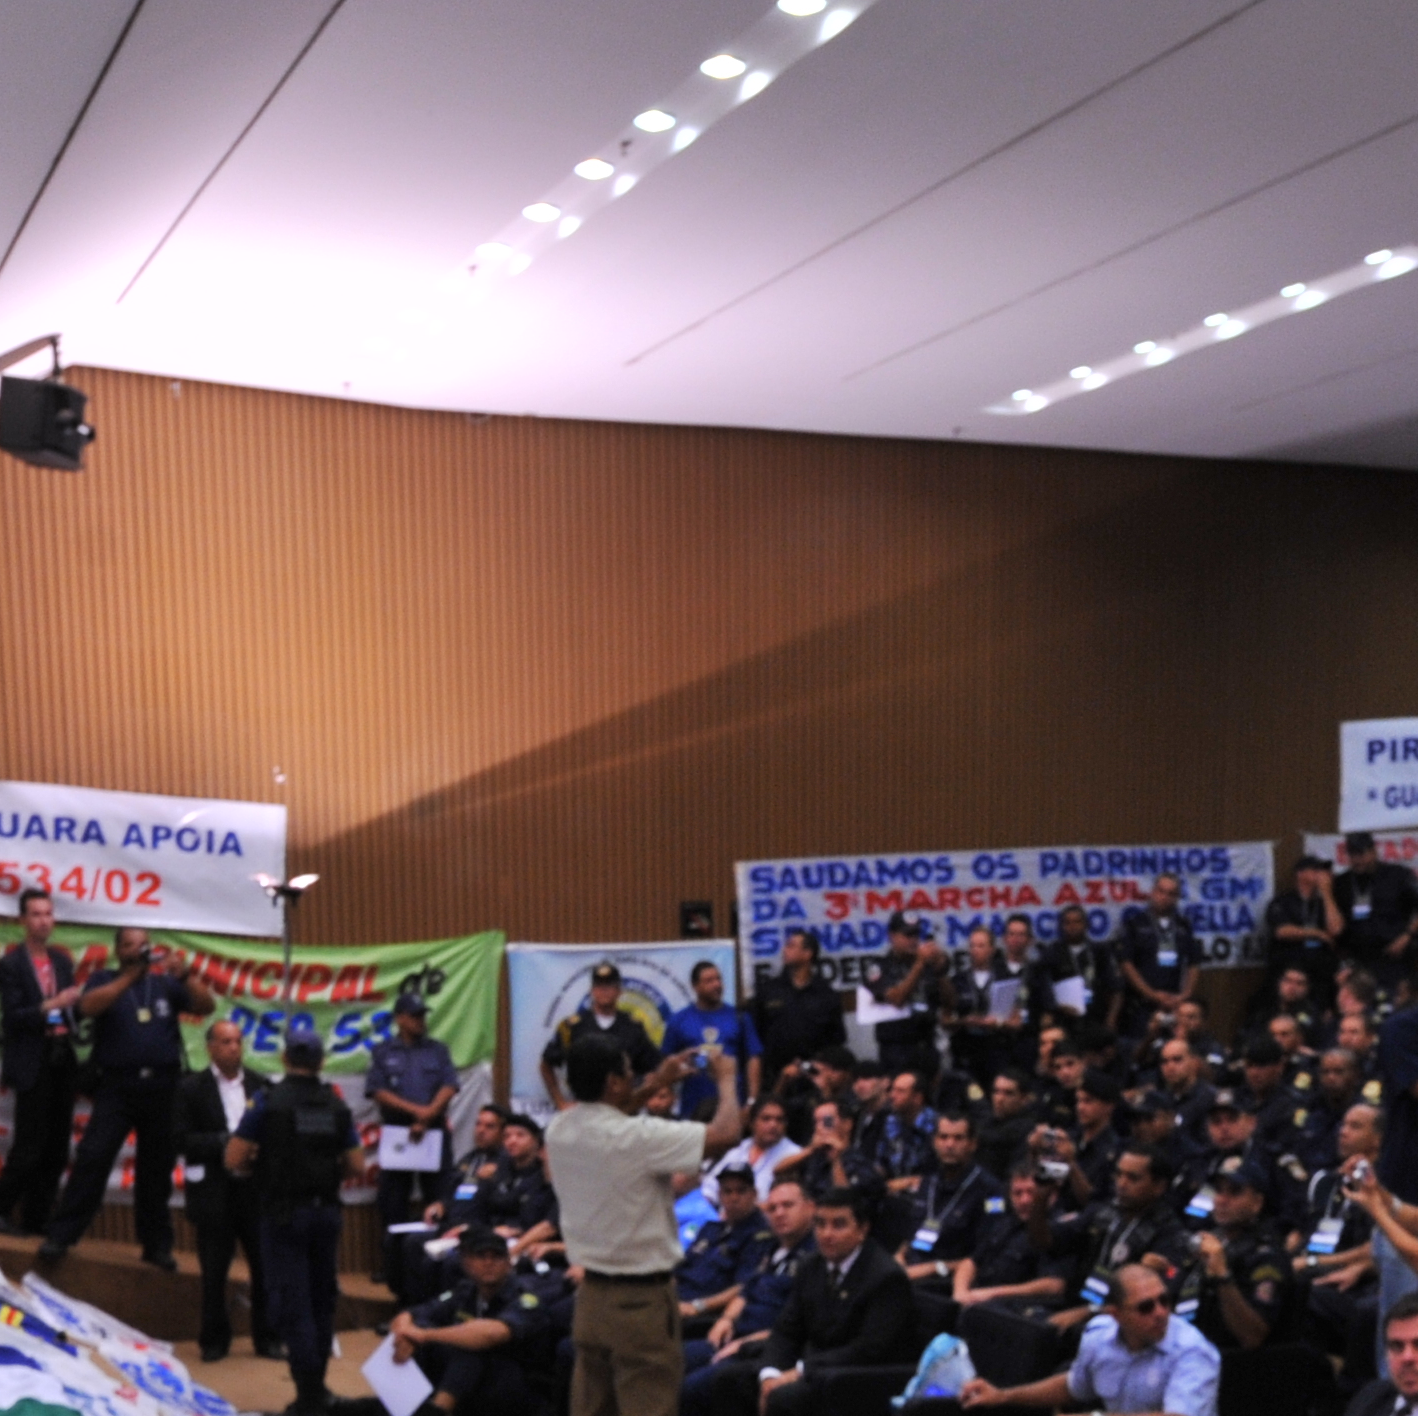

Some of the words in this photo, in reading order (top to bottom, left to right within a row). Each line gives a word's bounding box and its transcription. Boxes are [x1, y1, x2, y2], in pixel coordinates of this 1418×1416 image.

[122, 822, 244, 858] APOIA
[749, 855, 955, 894] SAUDAMOS
[972, 852, 1020, 881] OS
[1039, 847, 1231, 878] PADRINHOS
[751, 897, 807, 922] DA
[864, 885, 1042, 915] MARCHA
[1053, 878, 1151, 906] AZUL
